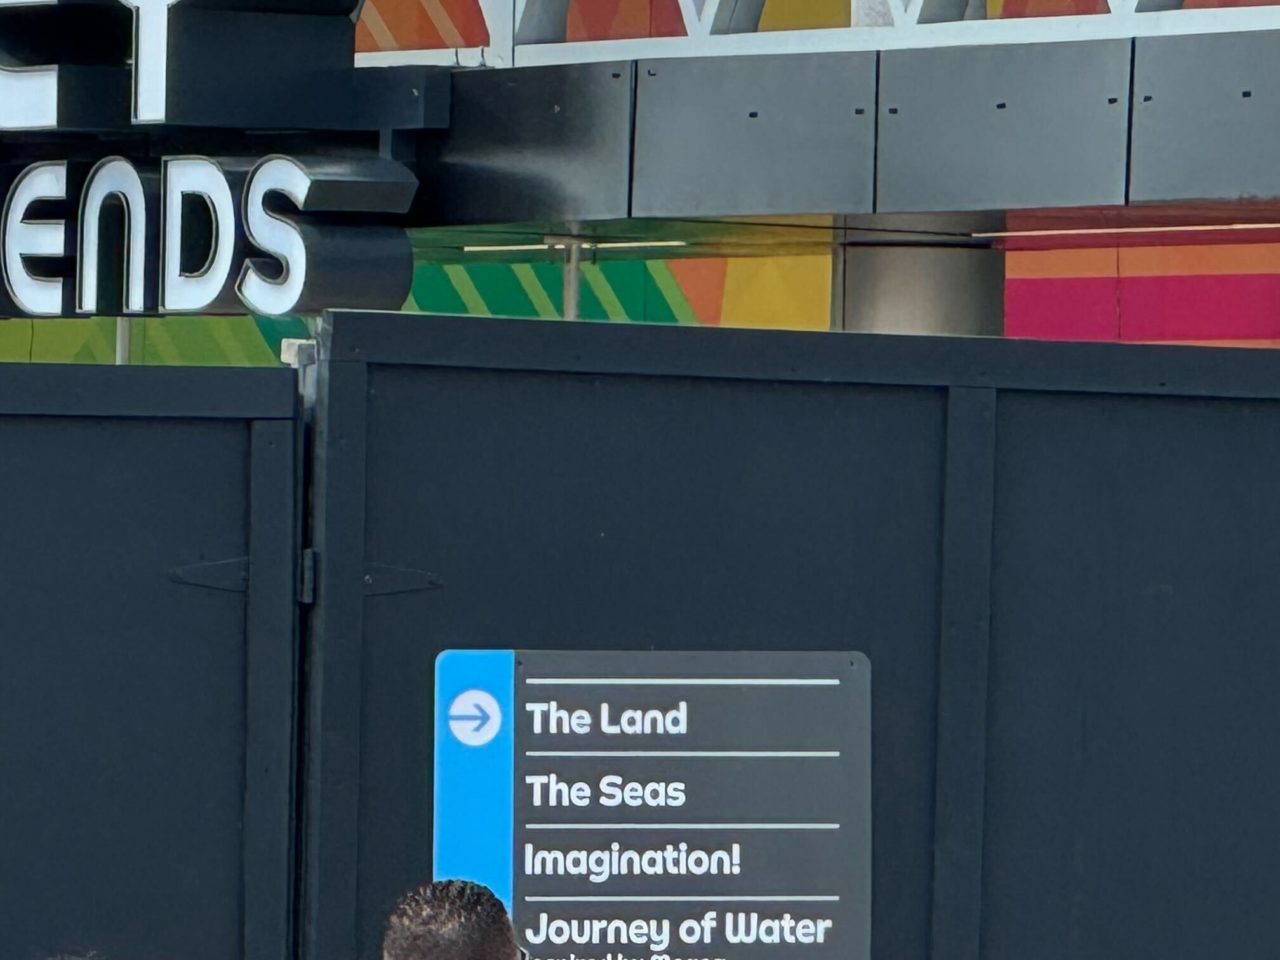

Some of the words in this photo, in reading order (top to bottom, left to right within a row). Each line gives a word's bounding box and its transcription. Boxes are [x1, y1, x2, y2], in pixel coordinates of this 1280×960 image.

[525, 701, 592, 734] The
[600, 701, 688, 734] Land
[525, 774, 591, 807] The
[599, 775, 686, 807] Seas
[524, 843, 740, 883] Imagination!
[525, 912, 670, 951] Journey
[678, 911, 717, 943] of
[725, 912, 832, 944] Water
